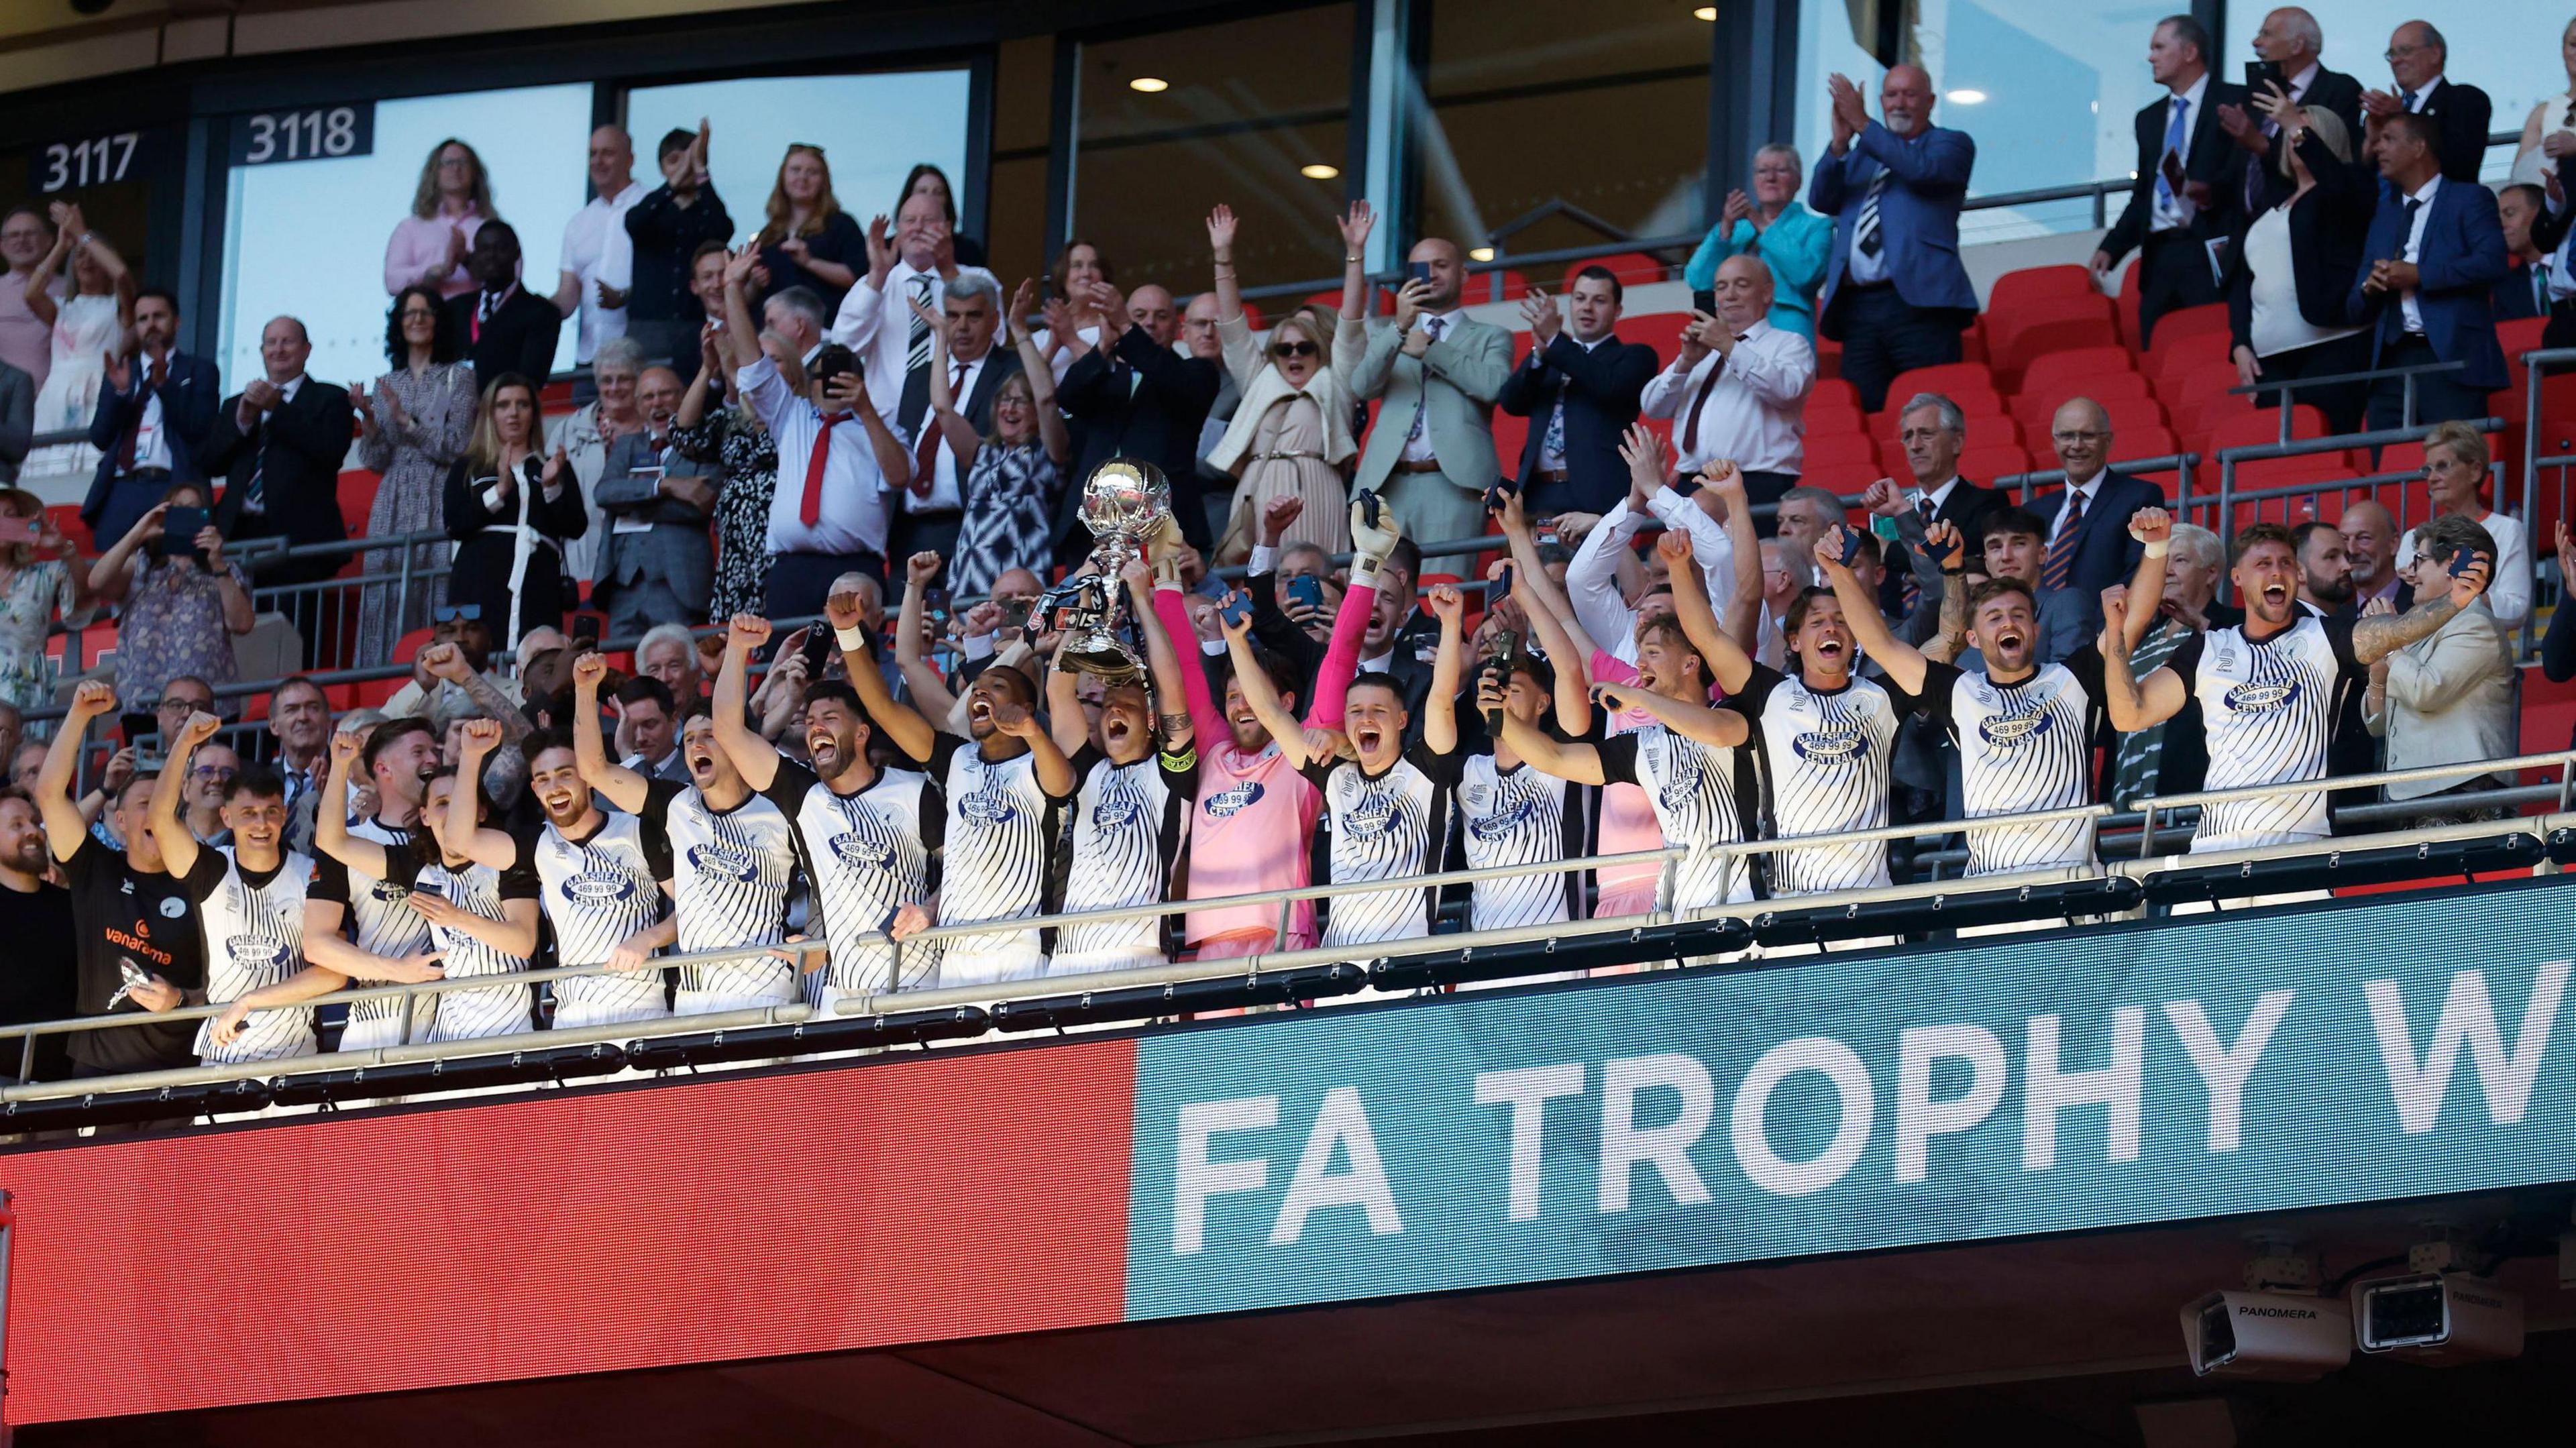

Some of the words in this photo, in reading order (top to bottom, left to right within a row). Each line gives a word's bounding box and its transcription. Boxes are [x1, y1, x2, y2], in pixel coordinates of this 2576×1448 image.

[246, 107, 355, 163] 3118
[42, 133, 138, 192] 3117
[2229, 679, 2294, 699] GATESHEAD
[2241, 693, 2257, 702] 469
[2259, 691, 2269, 700] 99
[2272, 689, 2283, 698] 99
[2235, 700, 2286, 713] CENTRAL
[1994, 726, 2009, 734] 469
[2012, 724, 2023, 732] 99
[2024, 720, 2034, 729] 99
[1797, 732, 1861, 744] GATESHEAD
[1990, 730, 2039, 746] CENTRAL
[1809, 741, 1825, 750] 469
[1828, 741, 1839, 750] 99
[1842, 741, 1851, 749] 99
[1805, 750, 1855, 765] CENTRAL
[962, 793, 1008, 812] GATESEAD
[1232, 795, 1241, 803] 99
[1114, 811, 1125, 820] 99
[1364, 822, 1375, 831] 99
[1483, 822, 1497, 832] 469
[1351, 829, 1389, 842] ENTRAL
[694, 844, 752, 870] GATESHEAD
[845, 844, 860, 854] 469
[861, 848, 871, 856] 99
[730, 865, 740, 874] 99
[566, 872, 628, 888] GATESHEAD
[578, 884, 592, 893] 469
[594, 884, 604, 893] 99
[606, 884, 616, 893] 99
[573, 893, 621, 907] CENTRAL
[106, 927, 172, 965] vanarama
[1173, 1087, 1404, 1256] FA
[1473, 989, 2296, 1223] TROPHY
[2364, 959, 2573, 1135] W
[2239, 1306, 2316, 1320] PANOMERA
